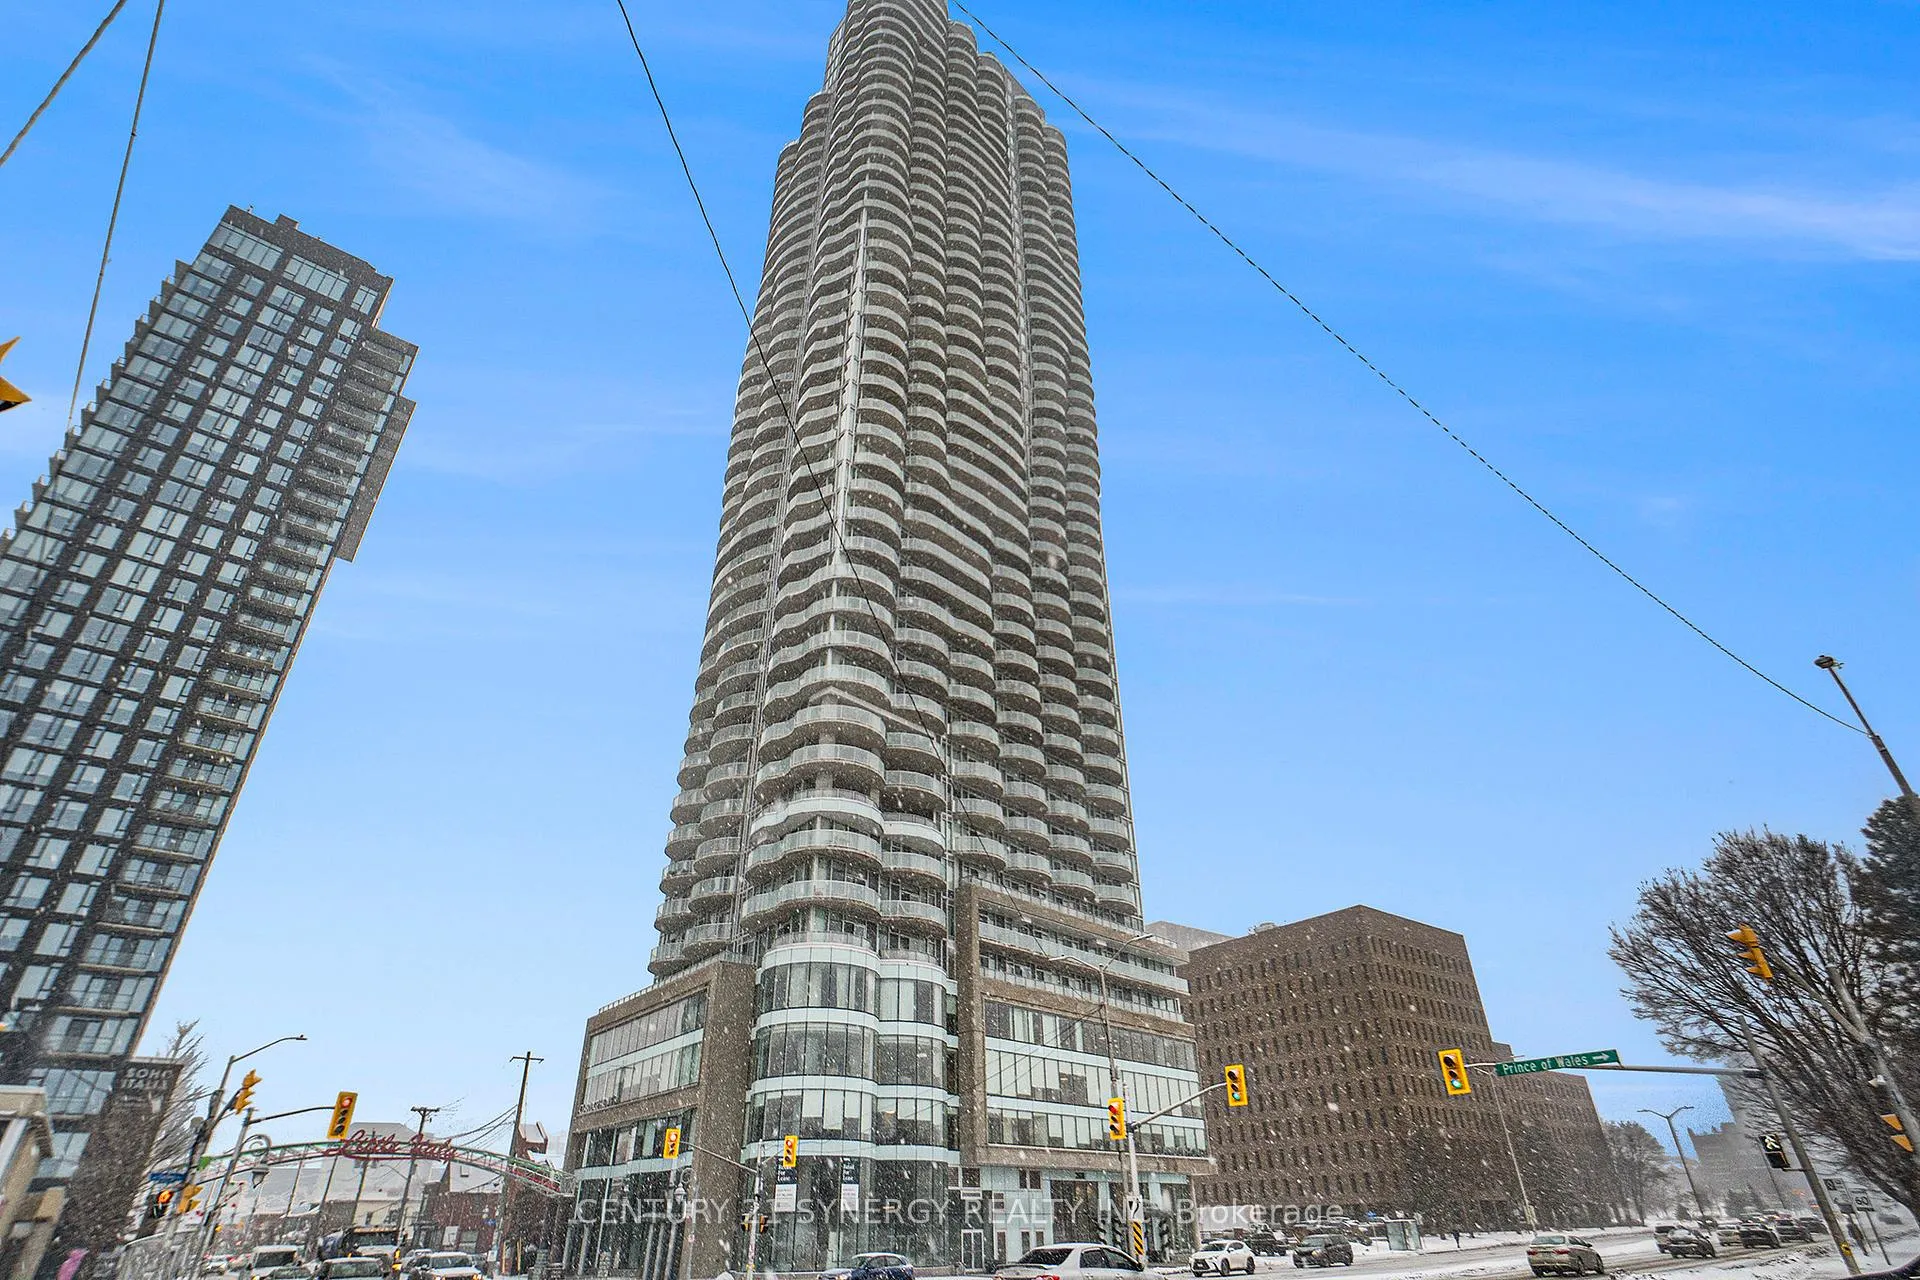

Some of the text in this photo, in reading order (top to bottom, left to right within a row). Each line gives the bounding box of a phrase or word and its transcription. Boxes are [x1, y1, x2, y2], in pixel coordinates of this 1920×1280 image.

[1502, 1056, 1589, 1075] Prince of Wales
